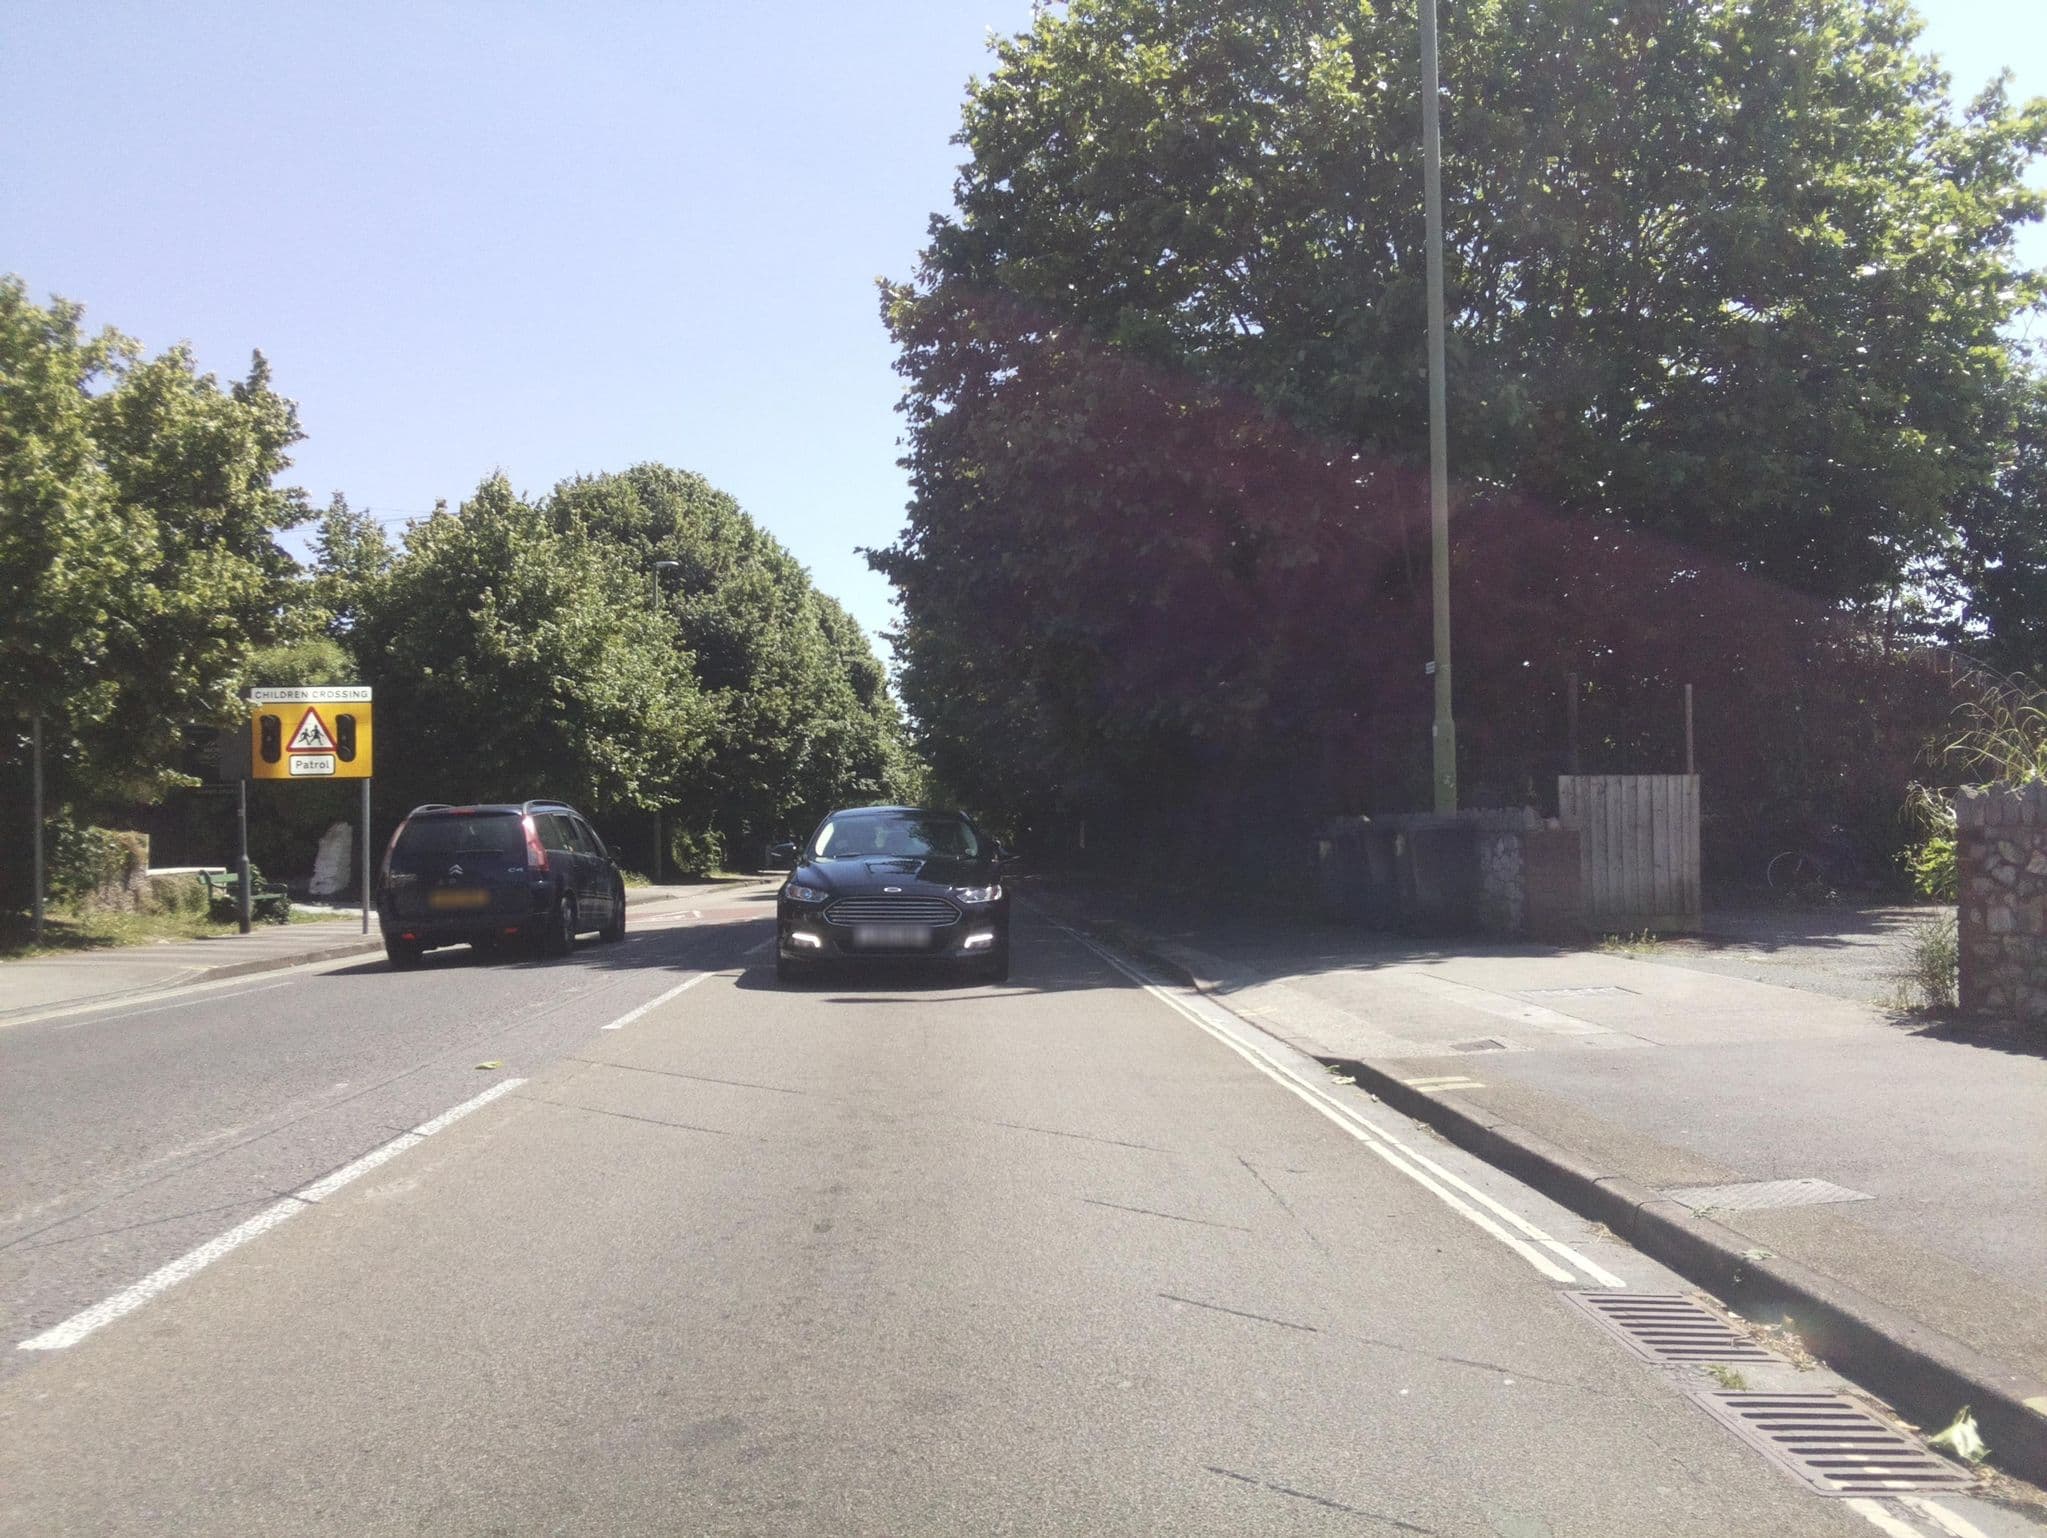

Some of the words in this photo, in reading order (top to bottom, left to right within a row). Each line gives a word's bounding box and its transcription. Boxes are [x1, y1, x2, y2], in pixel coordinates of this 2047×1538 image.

[254, 690, 309, 700] CHILDREN
[311, 690, 369, 699] CROSSING
[295, 759, 330, 769] Patrol
